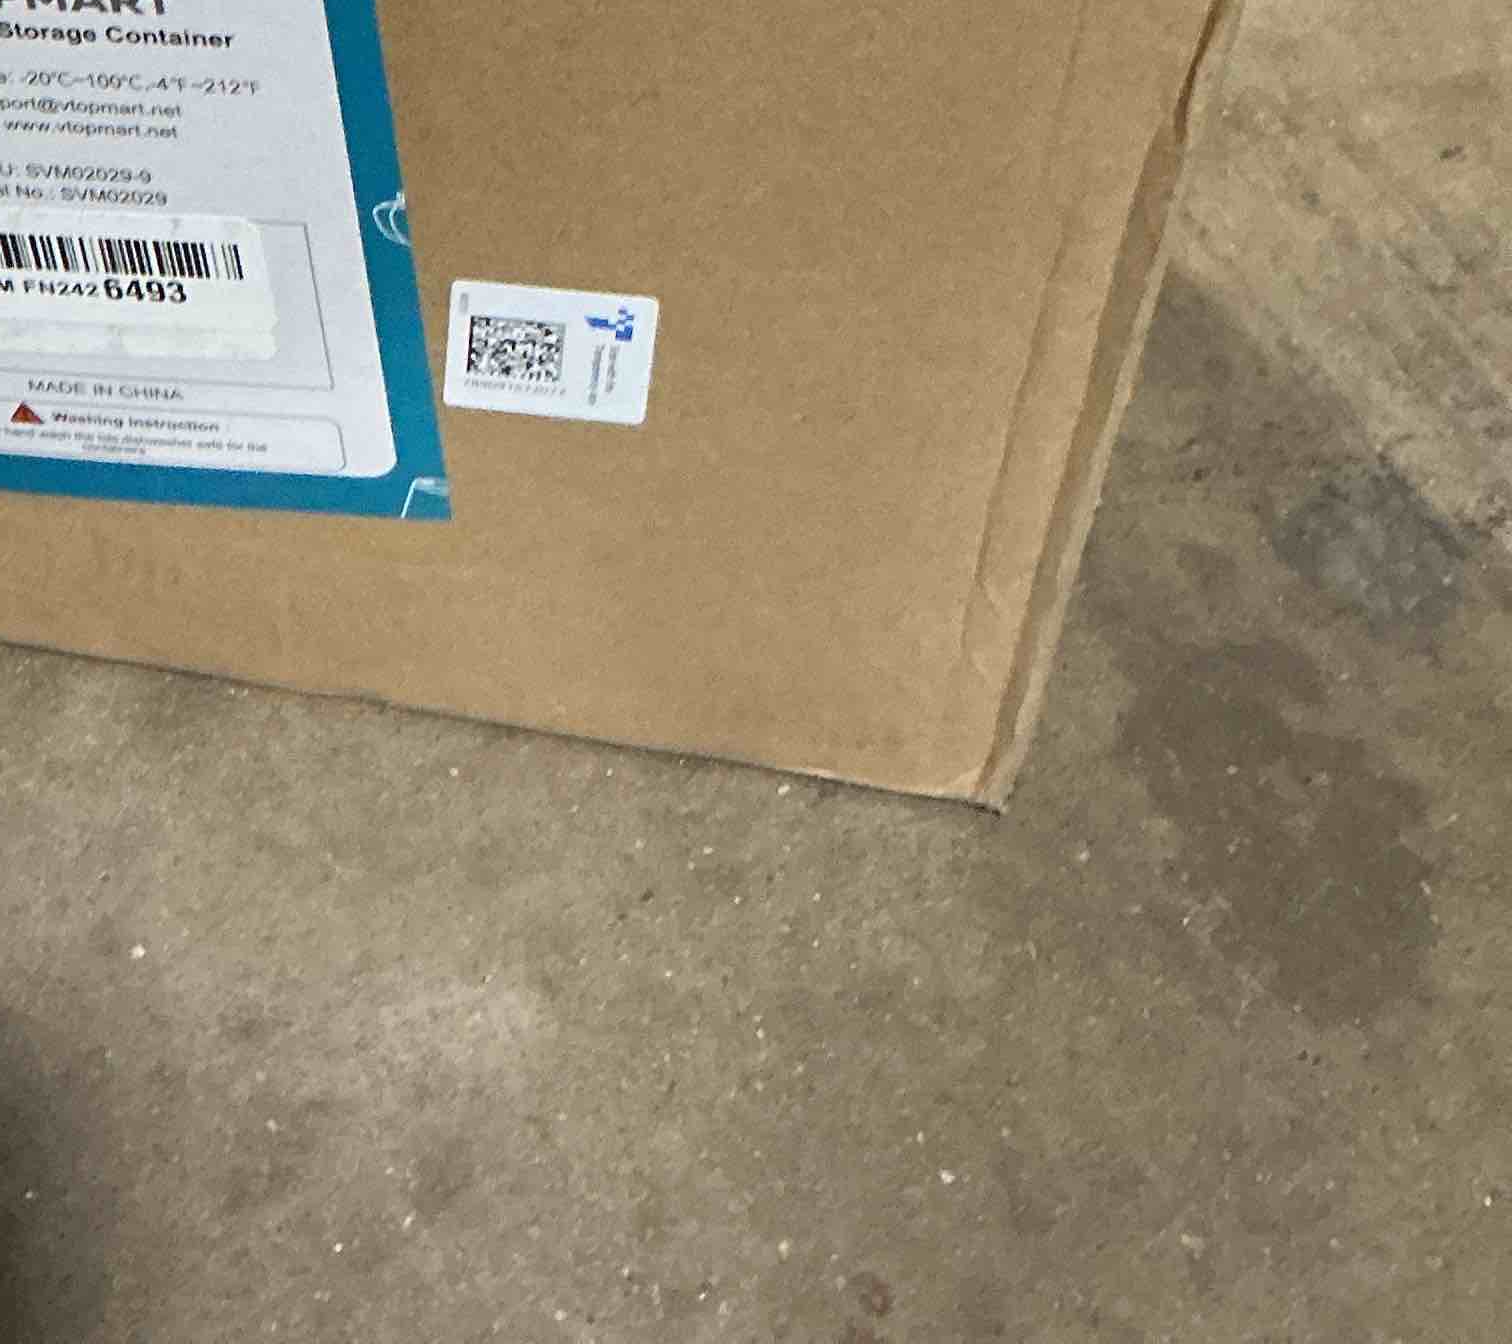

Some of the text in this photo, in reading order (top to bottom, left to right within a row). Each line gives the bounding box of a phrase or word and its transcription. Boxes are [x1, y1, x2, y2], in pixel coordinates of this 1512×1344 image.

[105, 25, 235, 49] Container
[27, 378, 185, 402] MADE IN CHINA
